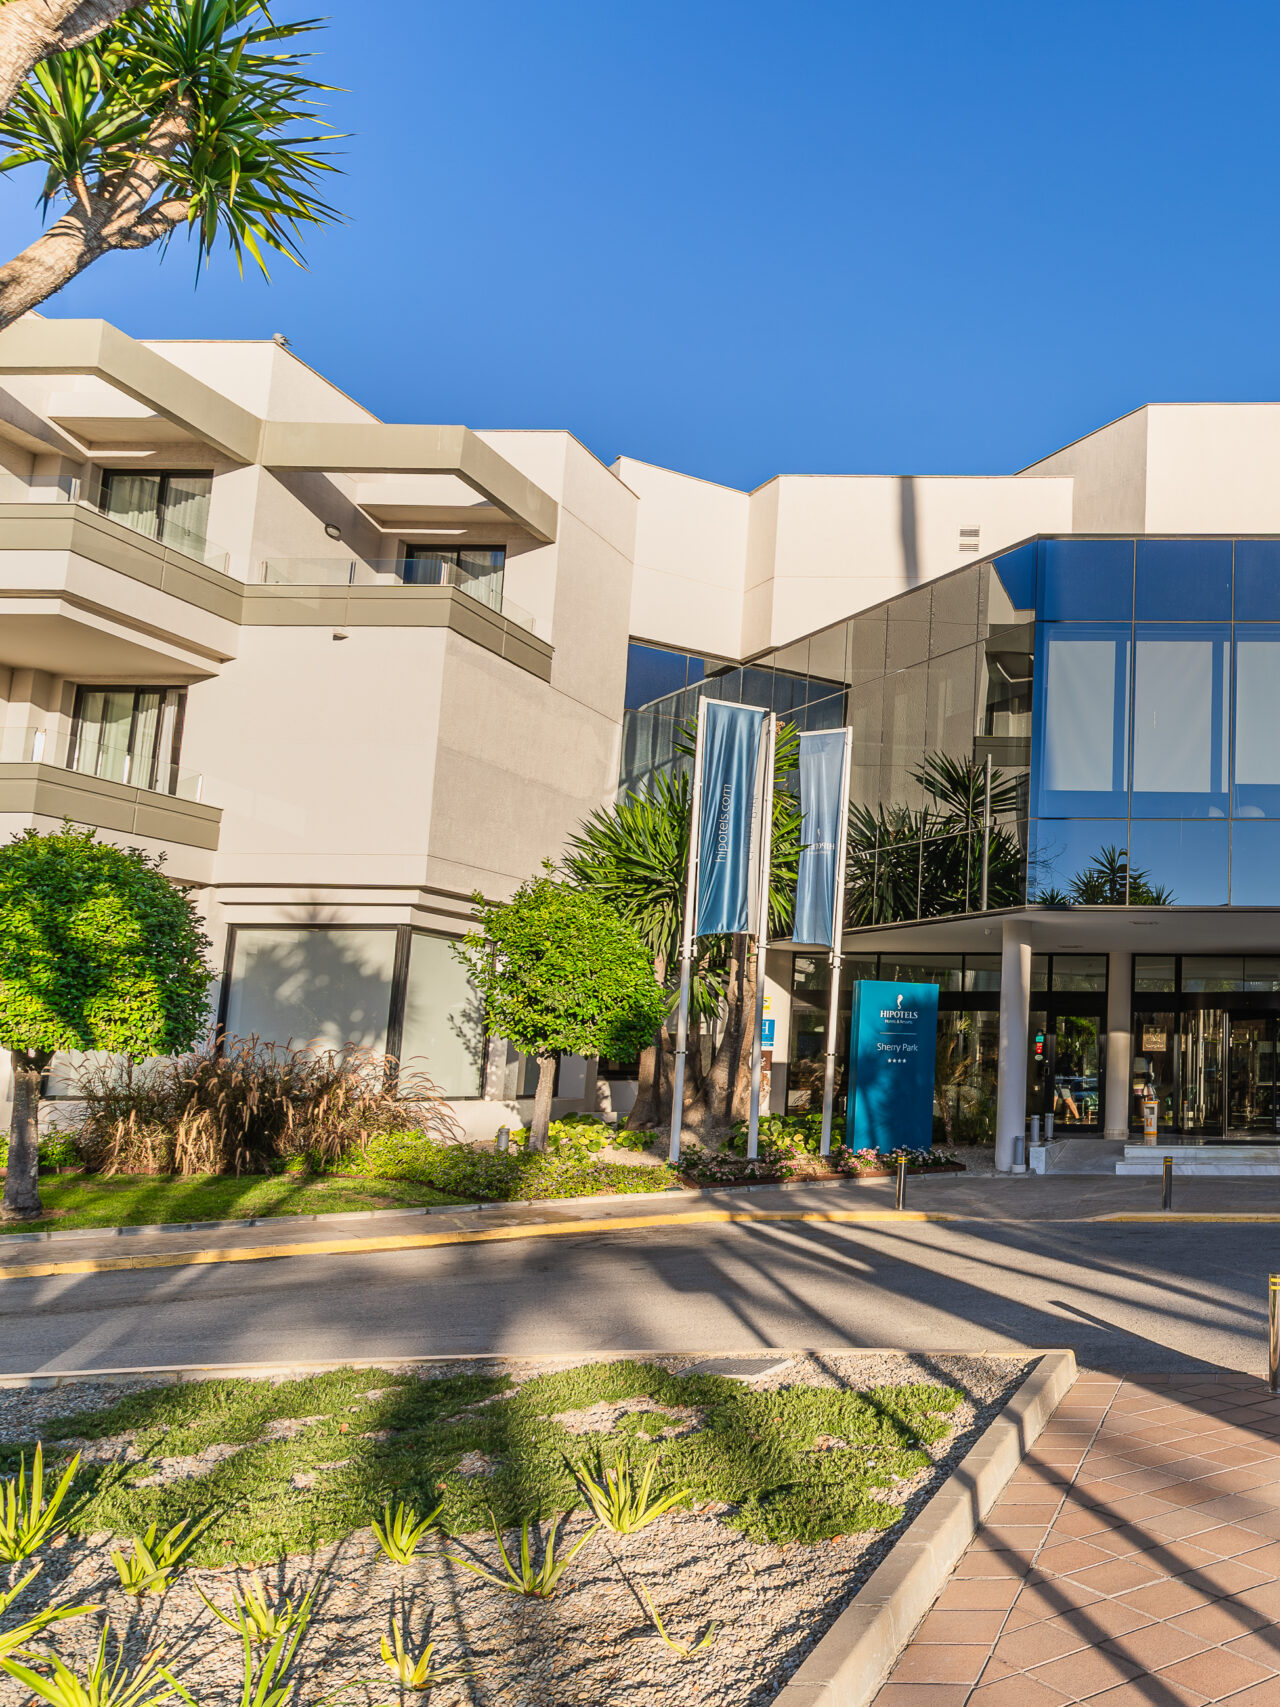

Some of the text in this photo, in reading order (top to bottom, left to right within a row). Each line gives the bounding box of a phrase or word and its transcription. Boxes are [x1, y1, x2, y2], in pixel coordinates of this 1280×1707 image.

[715, 784, 732, 862] hipotels.com
[880, 1010, 918, 1019] HIPOTELS
[877, 1042, 918, 1053] Sherry Park
